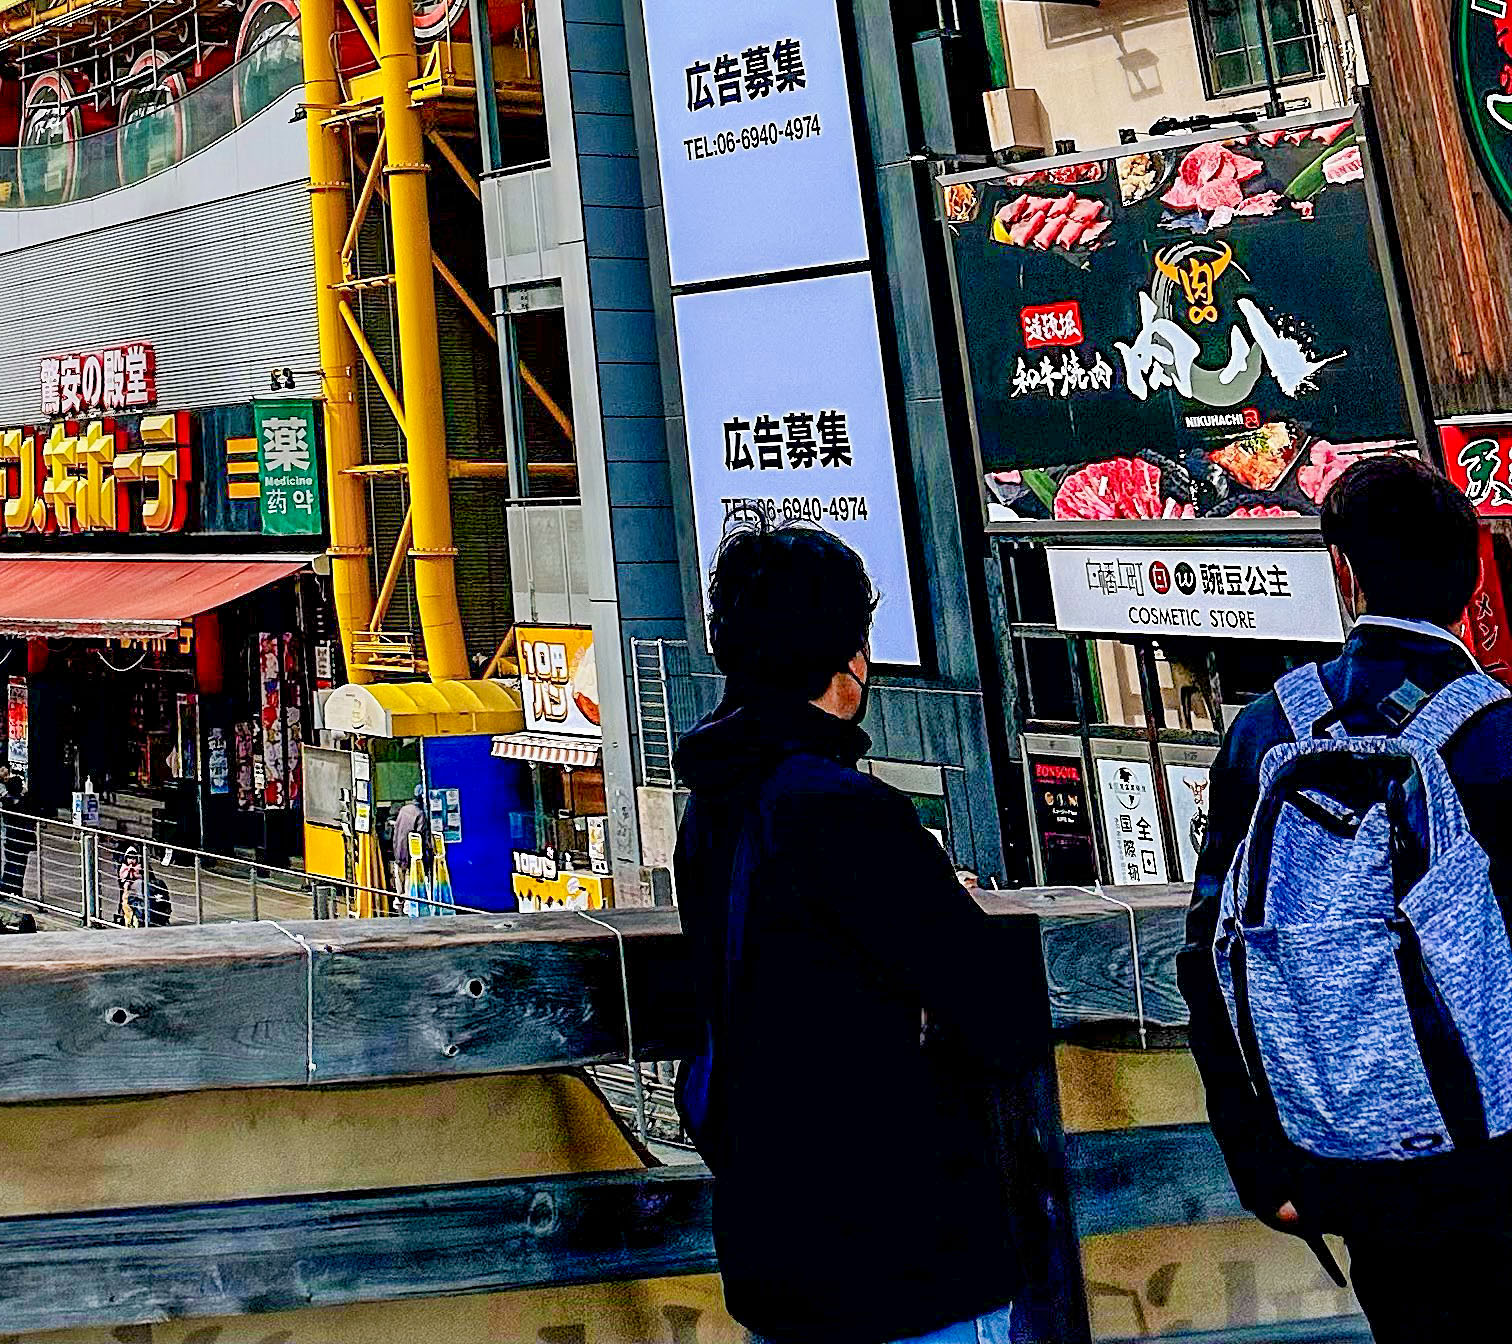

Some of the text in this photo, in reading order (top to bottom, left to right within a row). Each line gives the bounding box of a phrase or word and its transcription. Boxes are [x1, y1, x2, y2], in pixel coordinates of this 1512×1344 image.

[685, 38, 807, 113] 広告募集
[684, 113, 821, 161] TEL:06-6940-4974
[1010, 349, 1113, 398] 和牛焼肉
[1185, 414, 1244, 428] NIKUHACHI
[261, 416, 311, 472] 薬
[722, 410, 853, 472] 広告募集
[265, 476, 312, 486] Medicine
[267, 489, 287, 515] 药
[293, 489, 314, 516] 약
[1200, 564, 1291, 597] 豌豆公主
[1128, 607, 1257, 629] COSMETIC STORE
